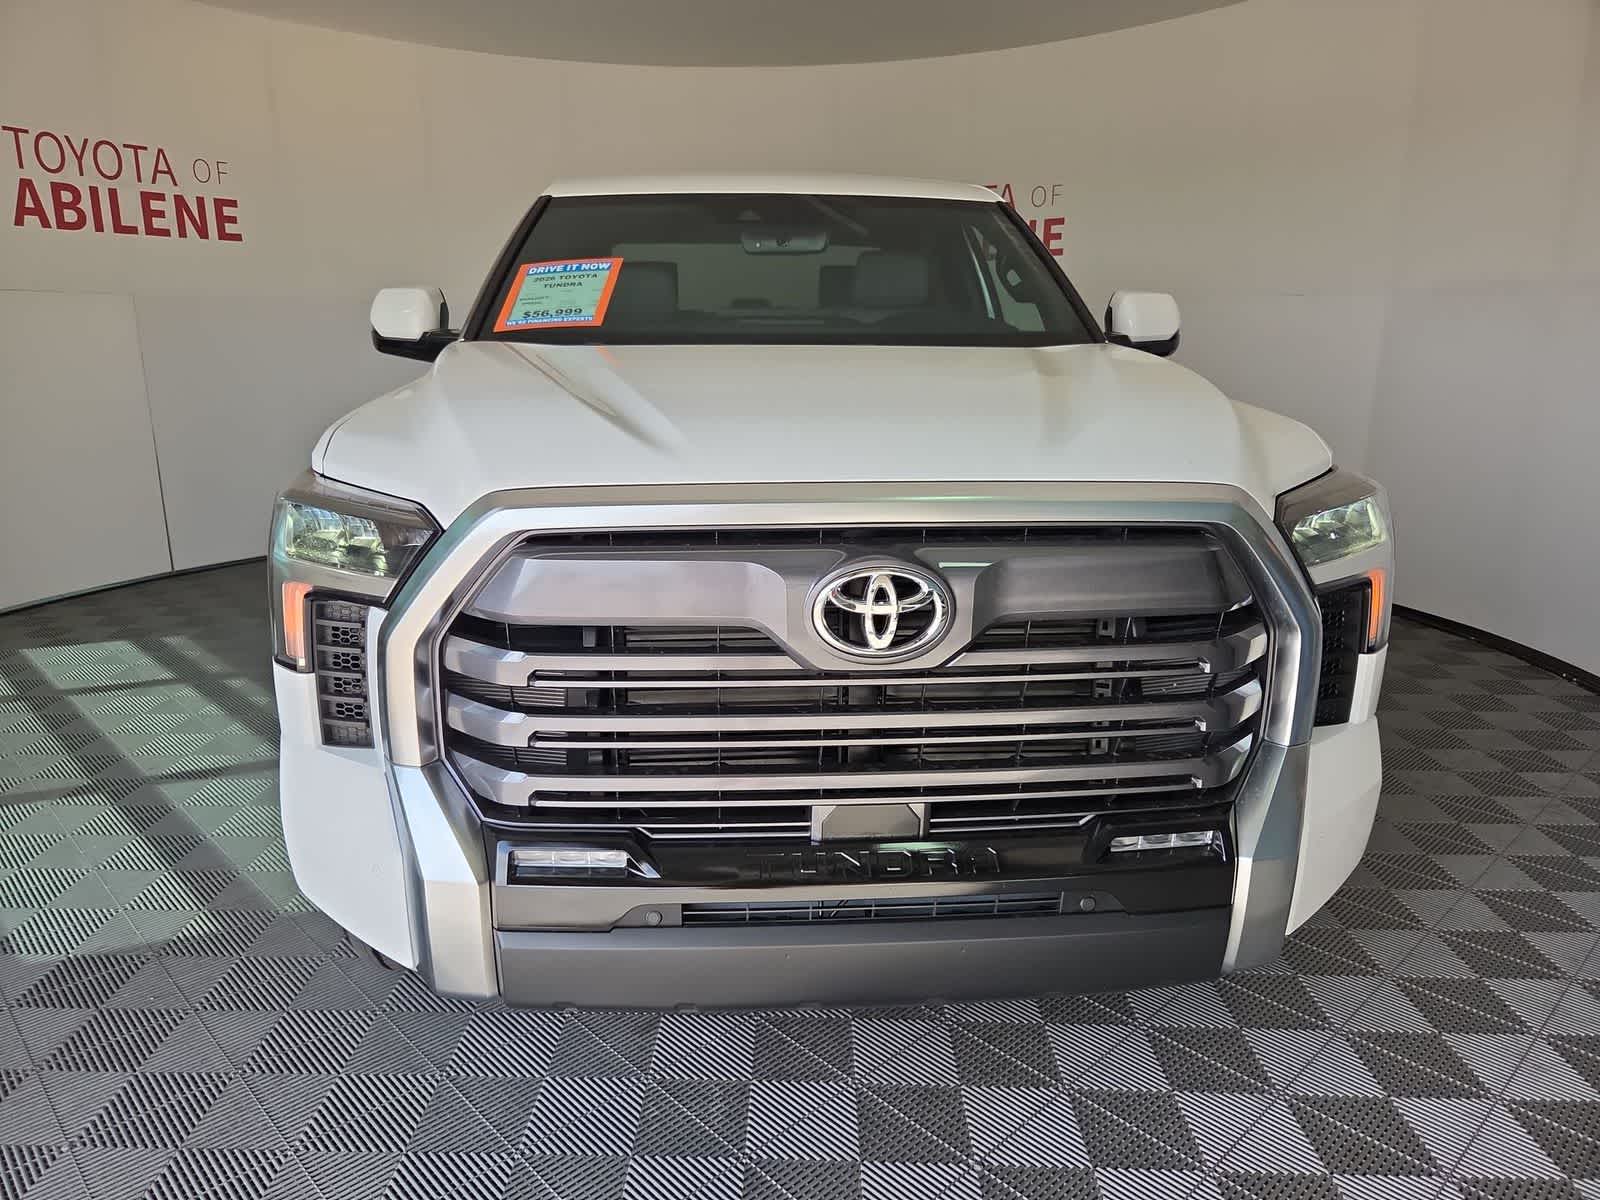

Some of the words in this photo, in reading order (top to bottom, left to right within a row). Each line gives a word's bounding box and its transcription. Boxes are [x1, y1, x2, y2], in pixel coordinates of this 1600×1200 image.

[1, 125, 178, 186] TOYOTA
[192, 158, 228, 184] OF
[1031, 184, 1064, 207] OF
[13, 177, 243, 242] ABILENE
[528, 265, 564, 274] DRIVE
[544, 281, 584, 289] TUNDRA
[523, 308, 582, 318] $56,999
[746, 847, 1000, 878] TUNDRA
